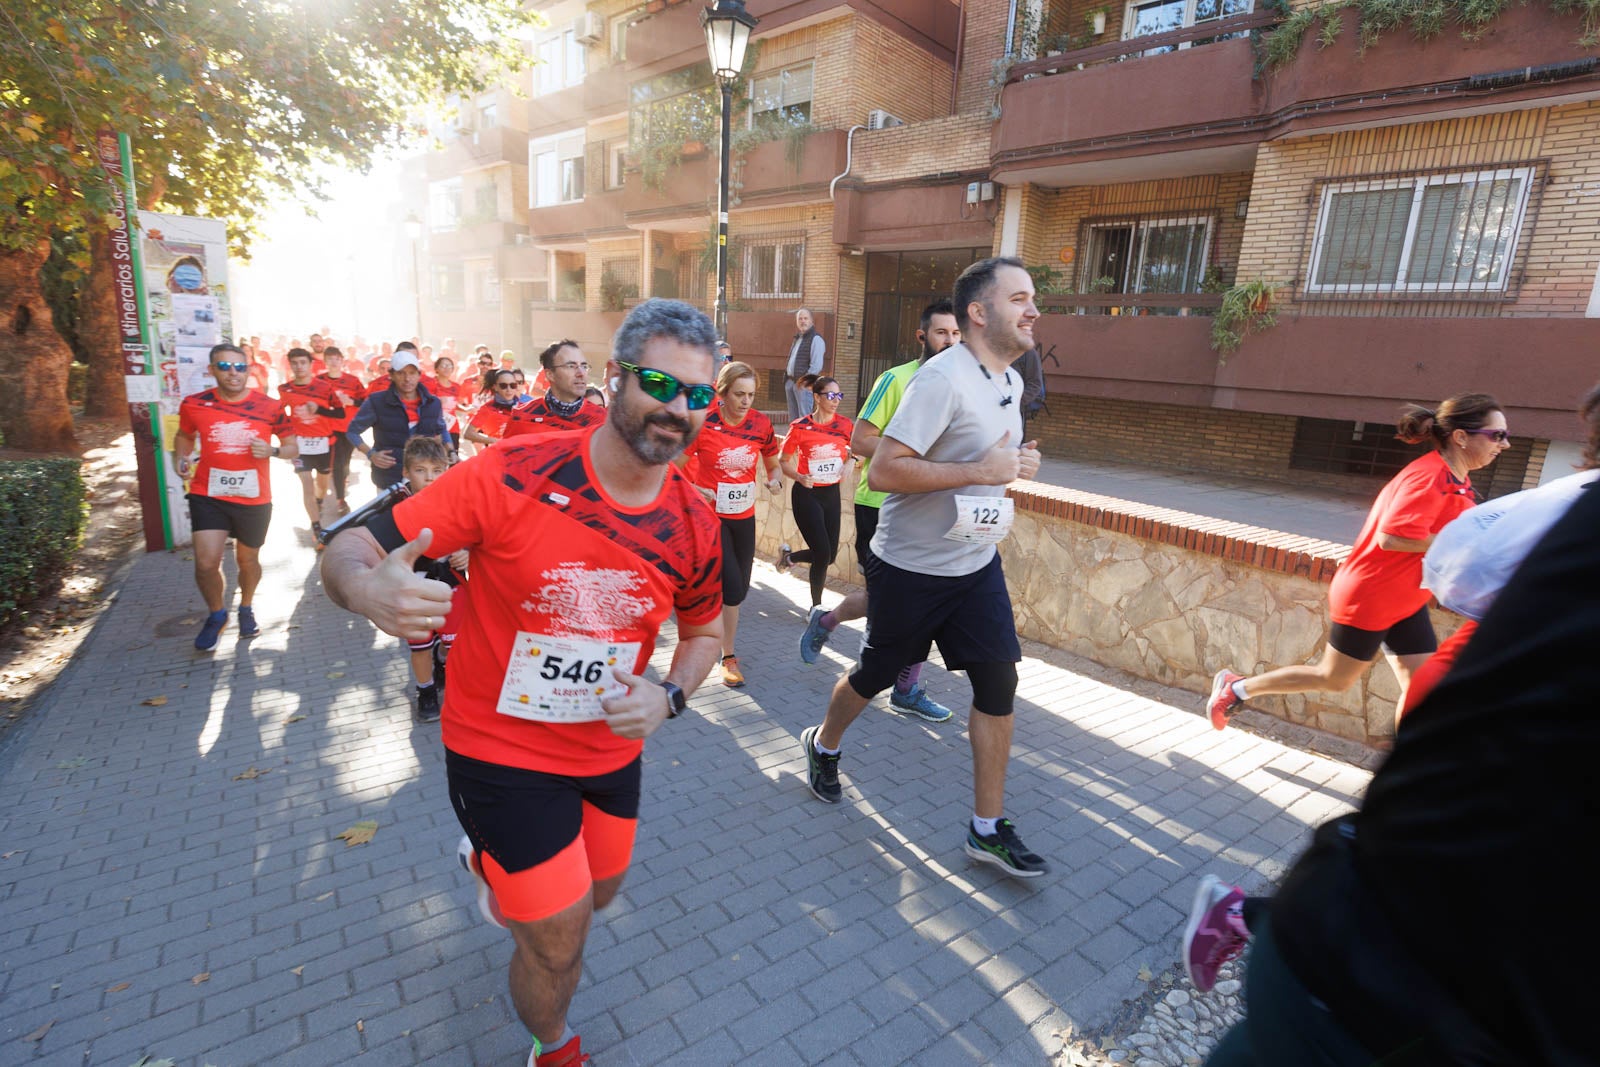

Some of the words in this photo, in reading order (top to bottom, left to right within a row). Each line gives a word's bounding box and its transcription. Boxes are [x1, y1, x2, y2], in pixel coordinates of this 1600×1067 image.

[817, 463, 835, 473] 457
[220, 476, 245, 486] 607
[728, 489, 748, 500] 634
[973, 507, 1000, 525] 122
[541, 584, 645, 618] carrera
[540, 655, 604, 684] 546
[552, 687, 589, 697] ALBERTO
